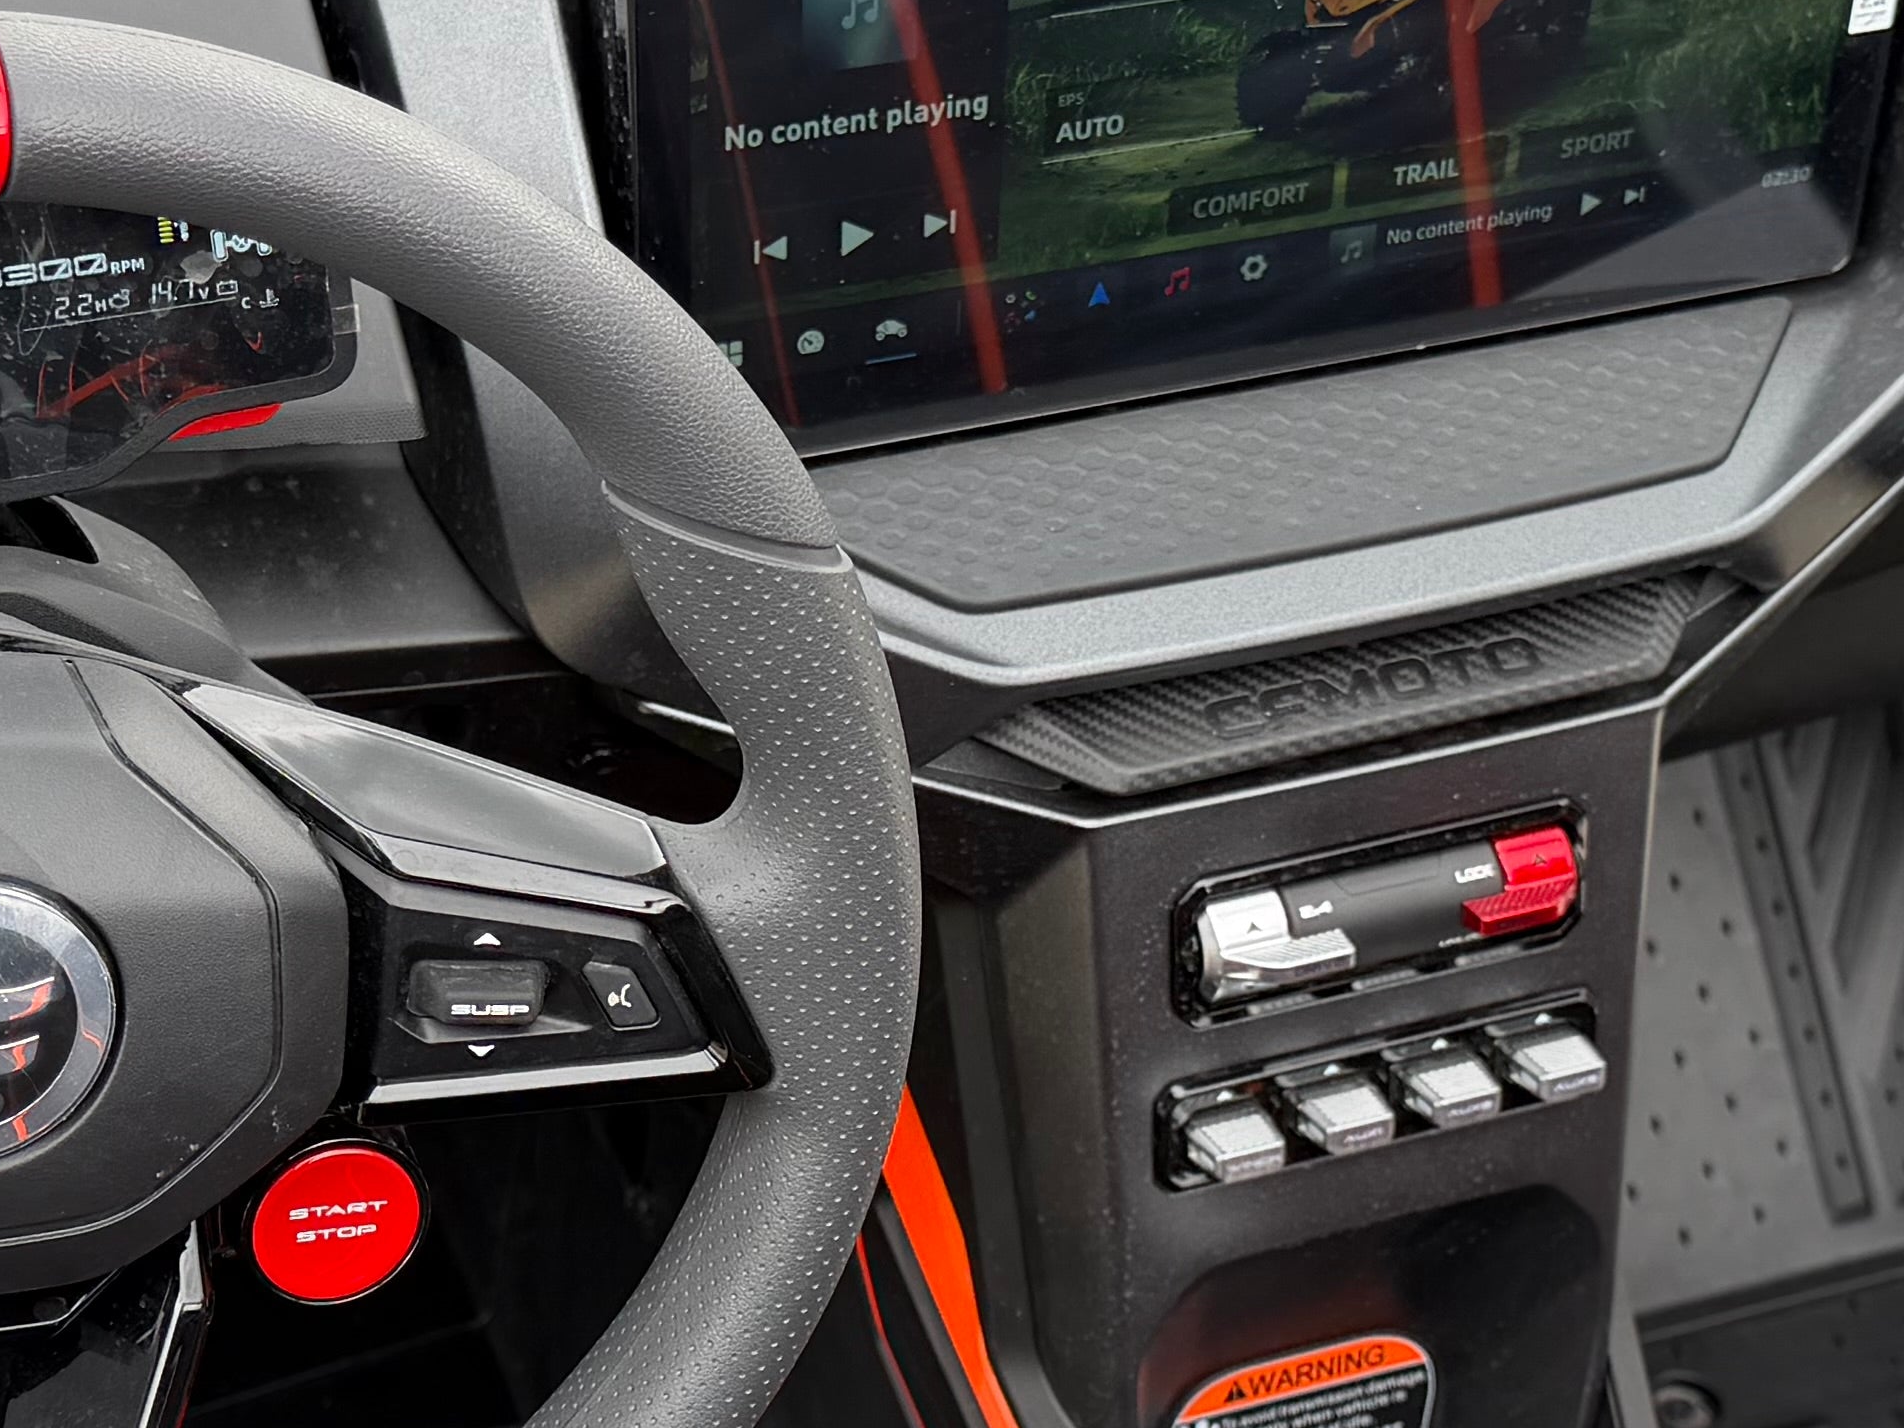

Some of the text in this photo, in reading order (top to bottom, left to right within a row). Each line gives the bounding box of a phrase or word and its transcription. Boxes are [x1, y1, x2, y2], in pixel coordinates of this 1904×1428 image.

[1058, 92, 1085, 108] EPS
[724, 94, 989, 151] No content playing
[1056, 114, 1124, 144] AUTO
[1560, 130, 1633, 160] SPORT
[1393, 158, 1459, 186] TRAIL
[1193, 182, 1309, 219] COMFORT
[1386, 203, 1553, 246] No content playing
[450, 1004, 530, 1016] SUSP
[289, 1200, 388, 1221] START
[296, 1224, 377, 1243] STOP
[1249, 1345, 1385, 1395] WARNING
